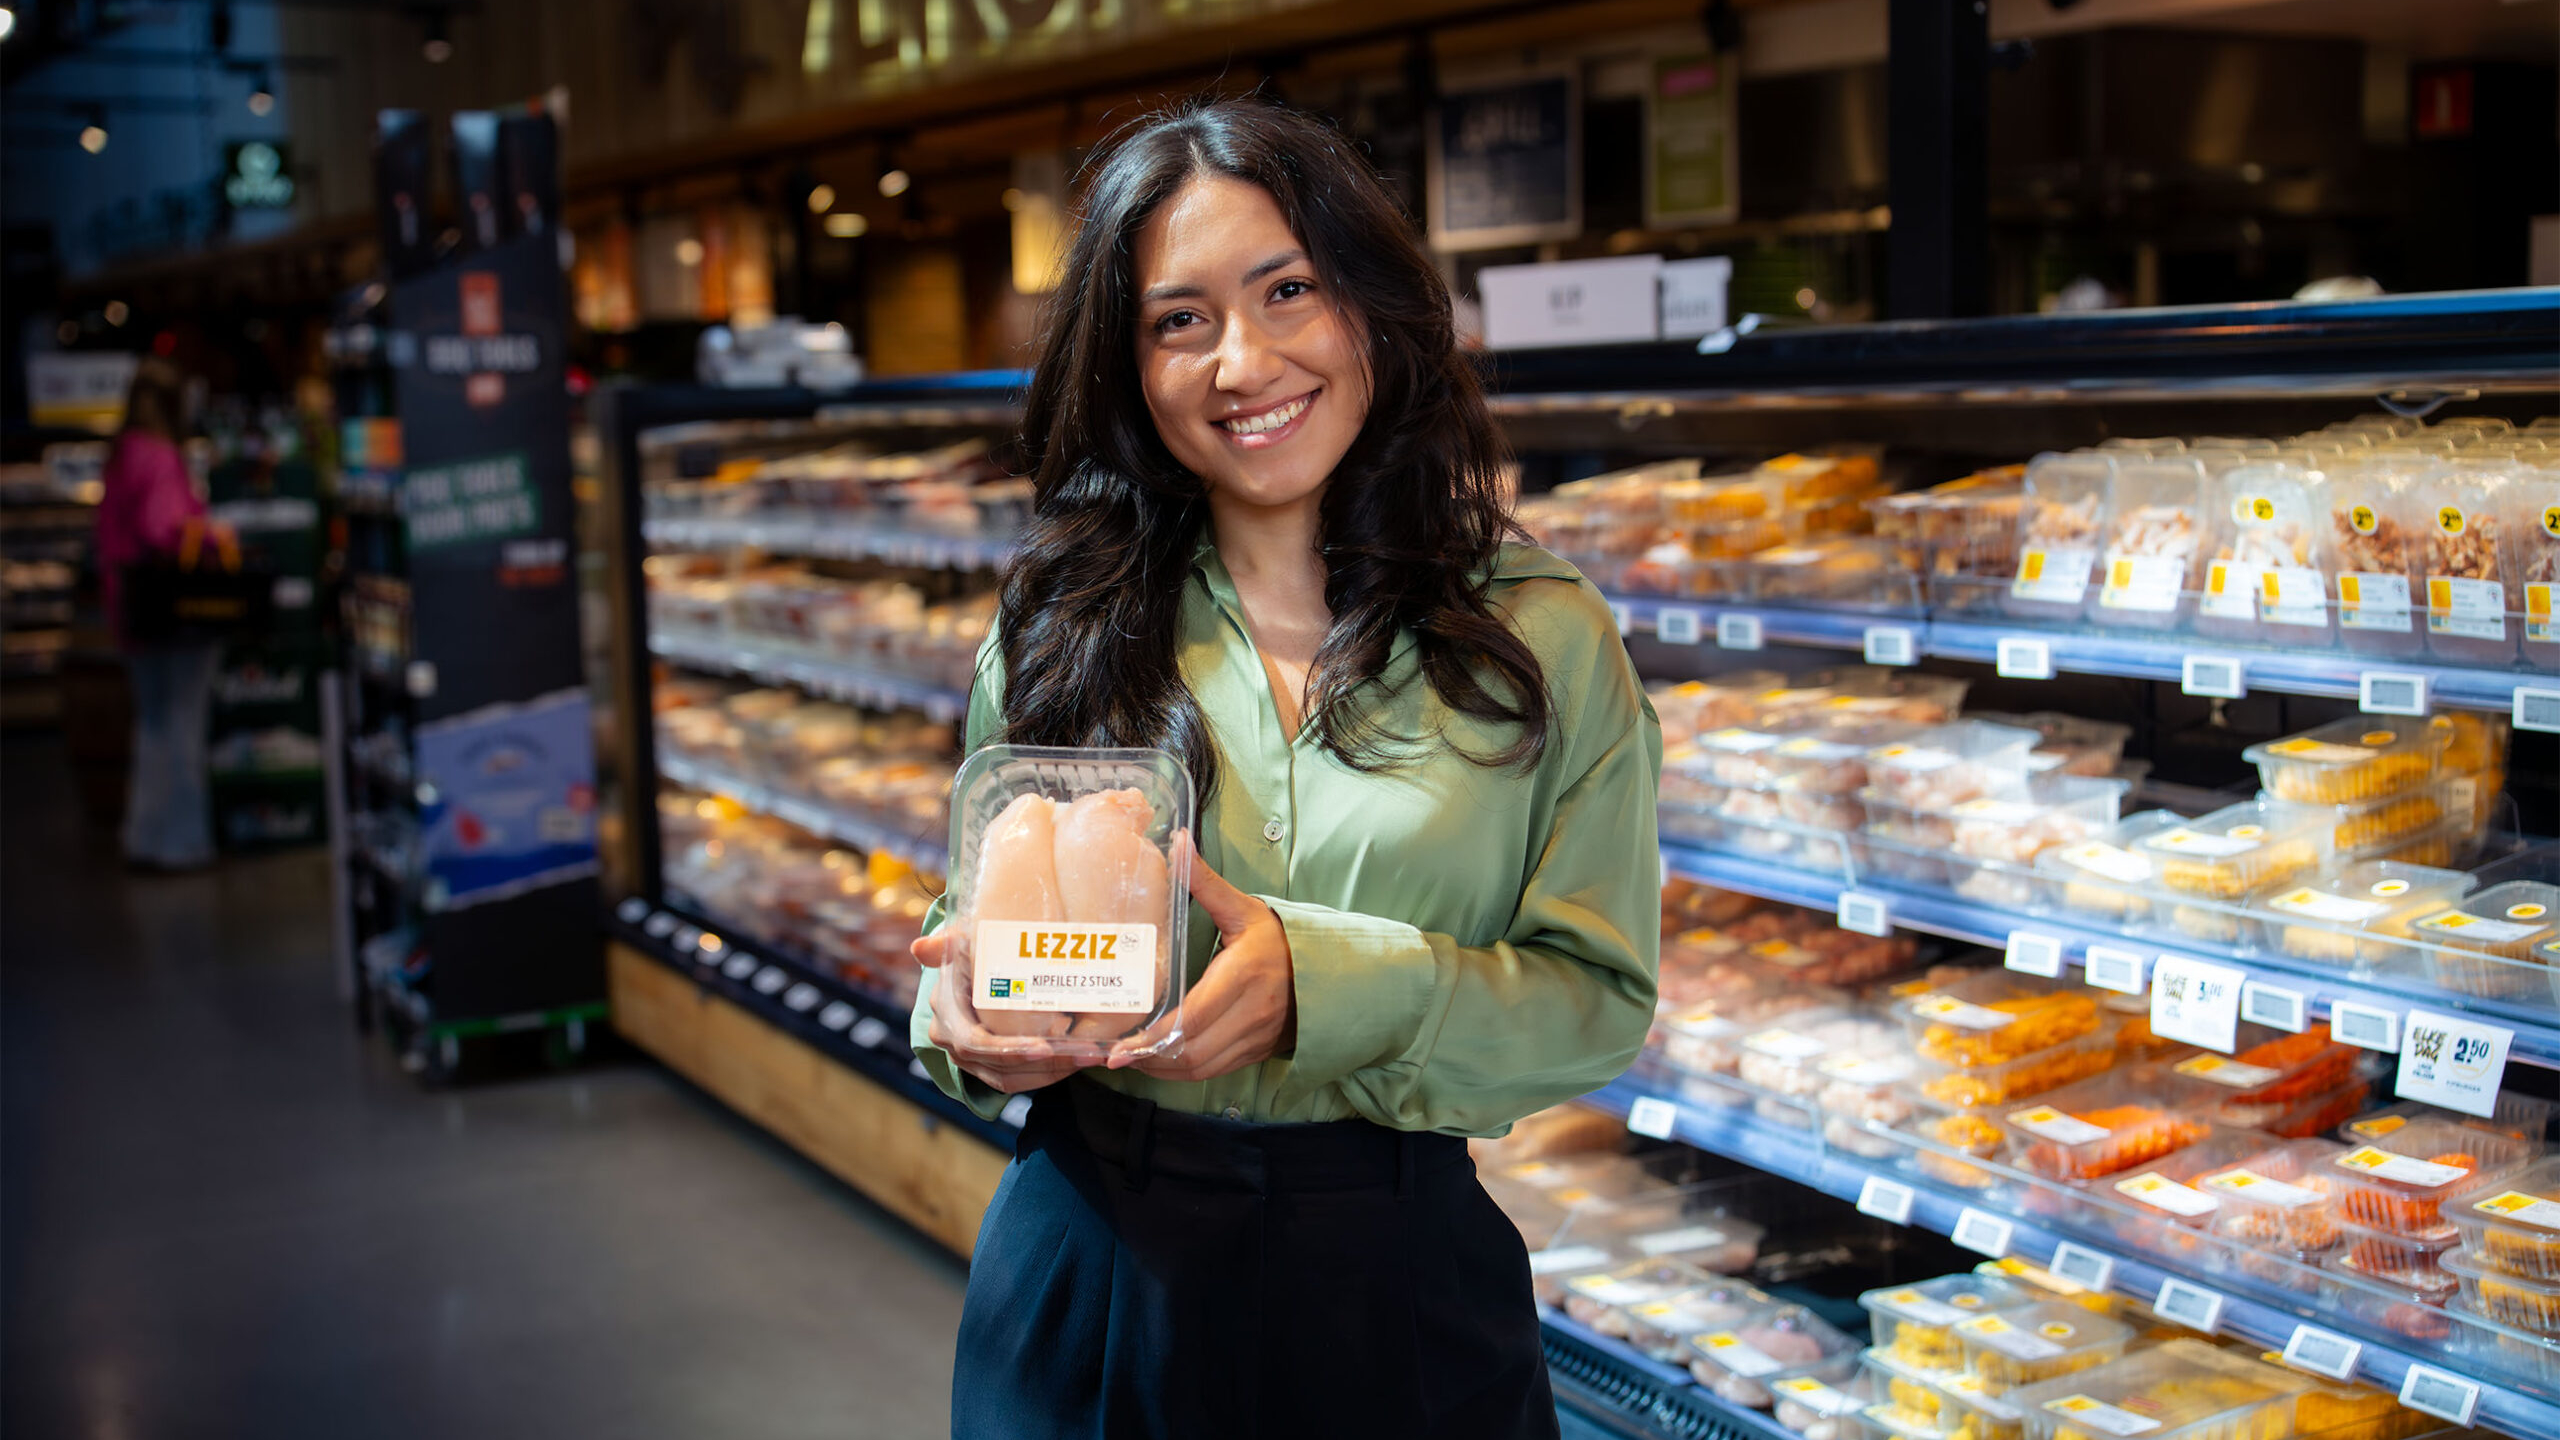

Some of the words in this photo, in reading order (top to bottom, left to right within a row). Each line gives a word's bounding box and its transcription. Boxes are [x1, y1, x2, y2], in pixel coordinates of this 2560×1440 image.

[1018, 931, 1118, 960] LEZZIZ
[1032, 975, 1079, 987] KIPFILET
[1080, 976, 1087, 987] 2
[1088, 976, 1123, 987] STUKS
[2413, 1026, 2448, 1045] ELKE
[2414, 1042, 2442, 1065] DAG
[2454, 1037, 2489, 1064] 2.50
